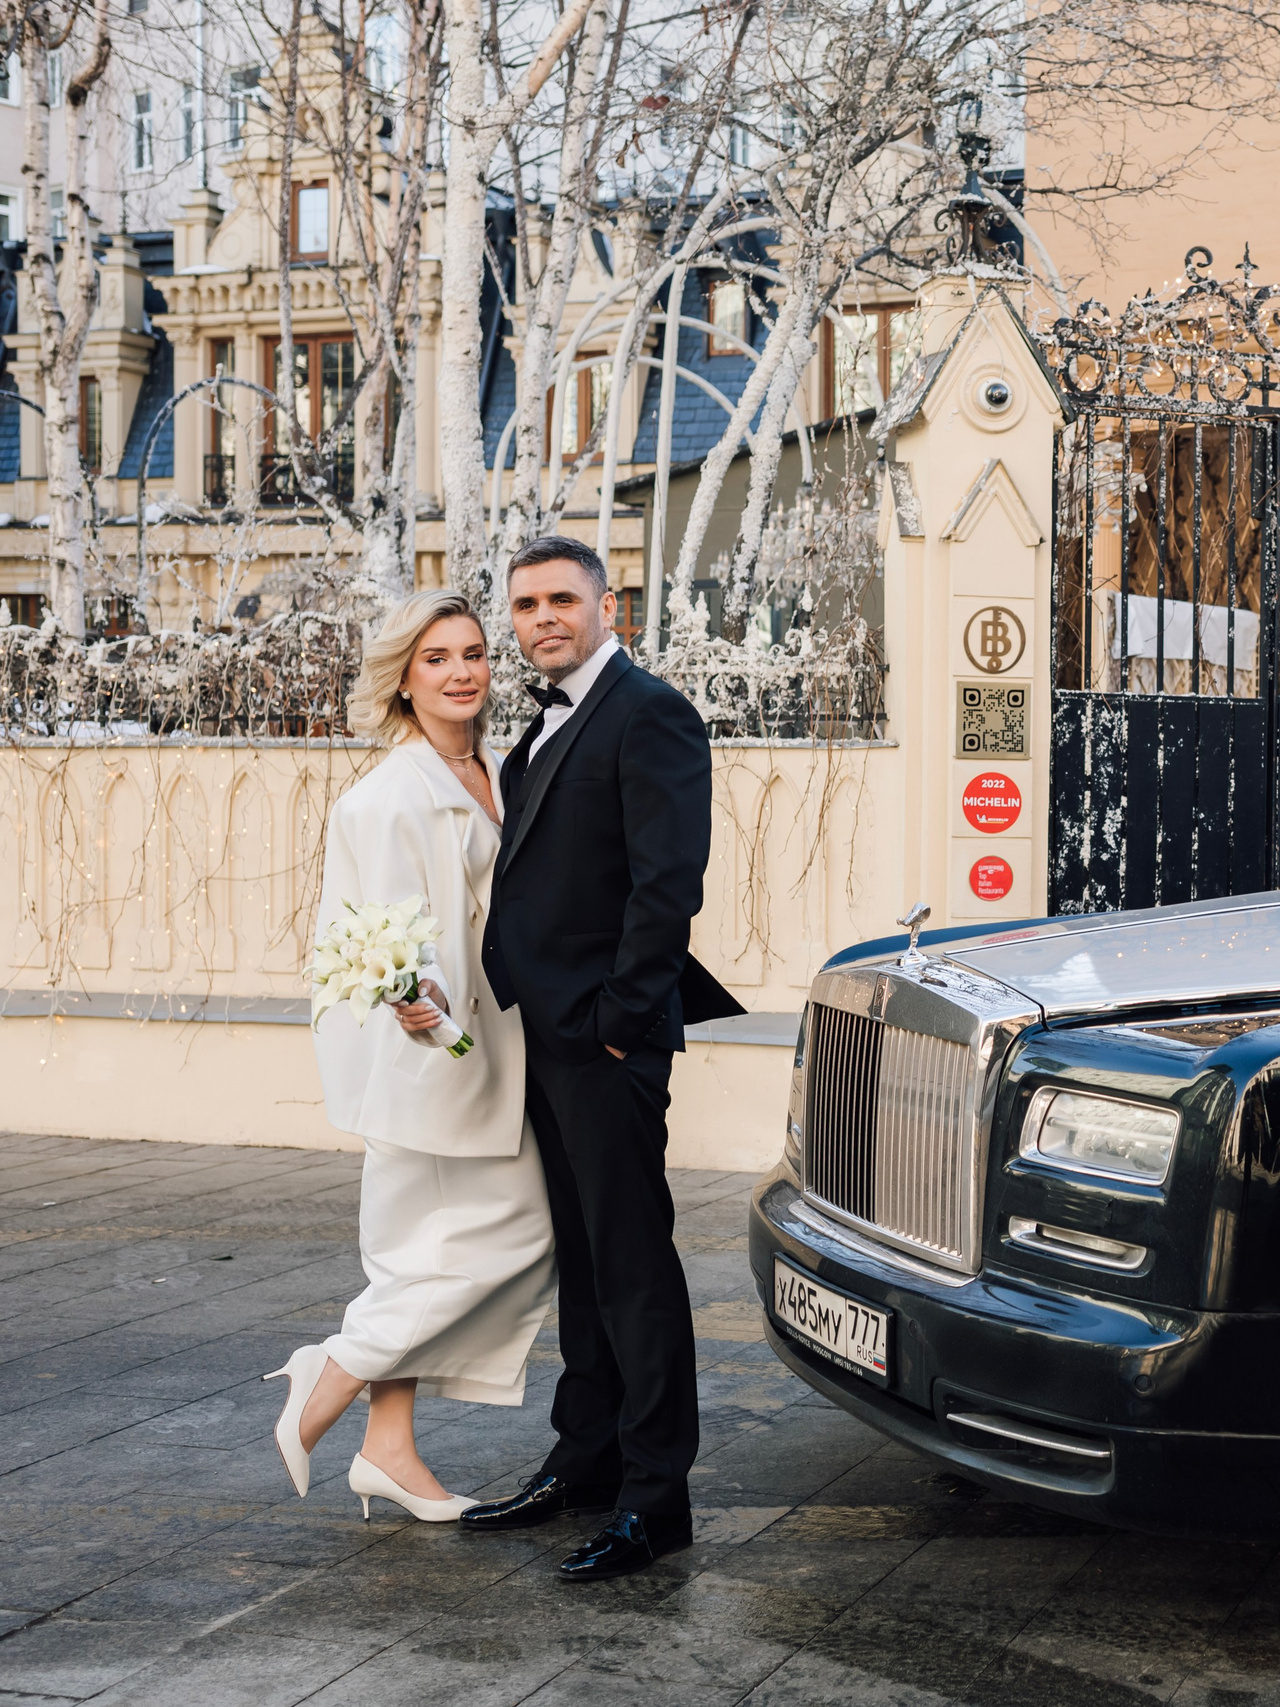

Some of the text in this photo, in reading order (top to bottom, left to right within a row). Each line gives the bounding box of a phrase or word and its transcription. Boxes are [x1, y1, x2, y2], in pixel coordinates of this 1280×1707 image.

[981, 779, 1005, 788] 2022
[963, 796, 1020, 807] MICHELIN
[848, 1304, 880, 1350] 777
[812, 1343, 832, 1360] MOSCOW
[856, 1345, 873, 1364] RUS
